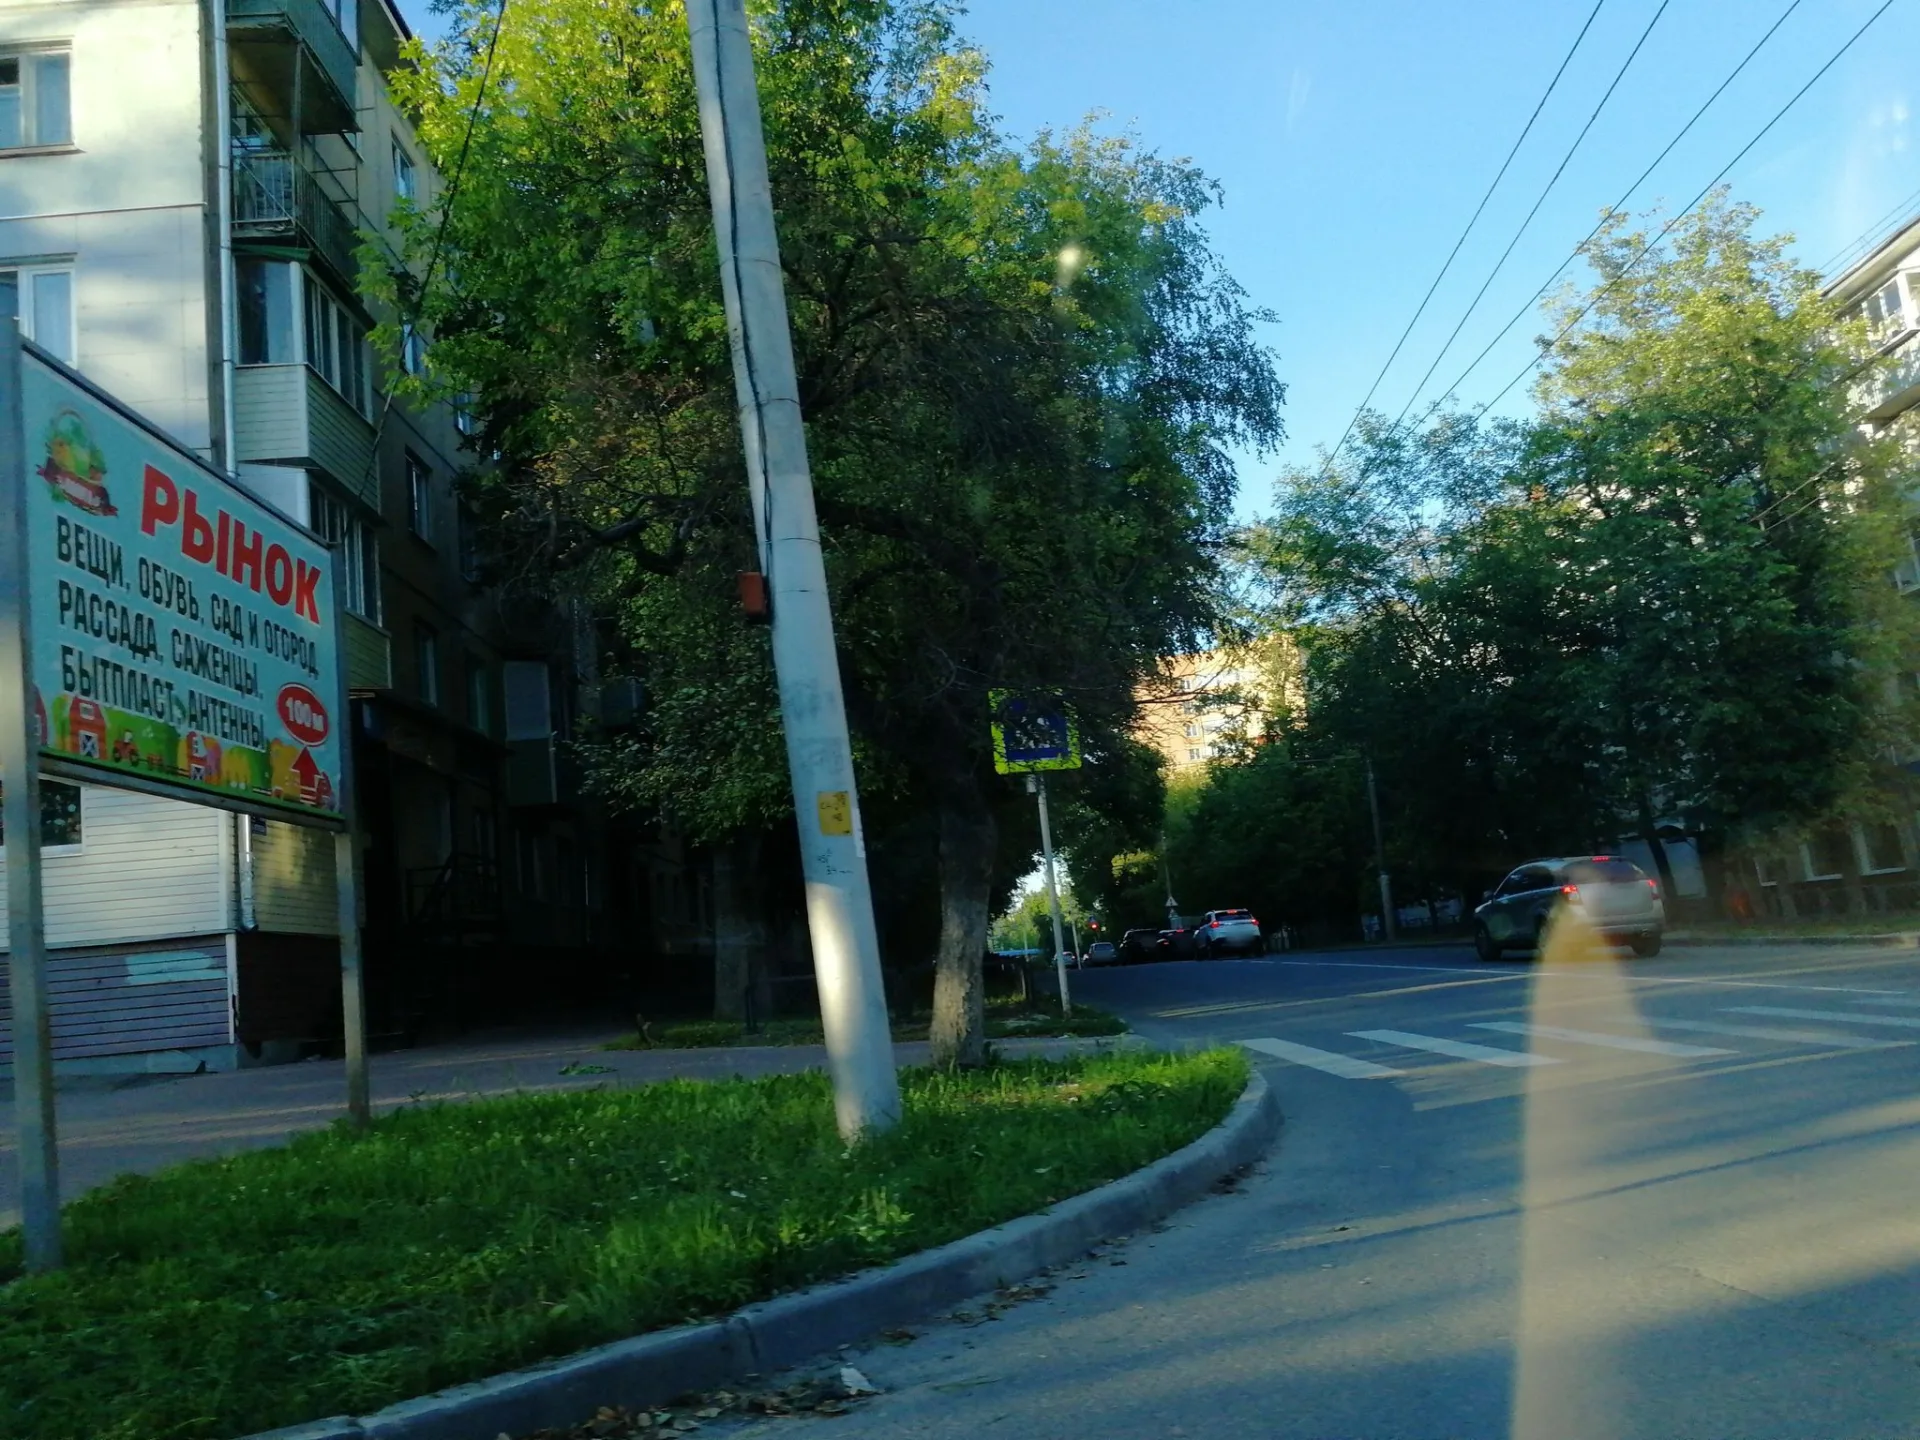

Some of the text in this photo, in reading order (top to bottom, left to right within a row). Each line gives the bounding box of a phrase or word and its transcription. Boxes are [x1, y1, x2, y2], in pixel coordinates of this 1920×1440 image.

[57, 515, 130, 592] ВЕЩИ,
[211, 593, 245, 648] САД
[248, 611, 260, 649] И
[140, 464, 321, 624] РЫНОК
[59, 580, 163, 664] РАССАДА,
[188, 690, 265, 749] АНТЕННЫ
